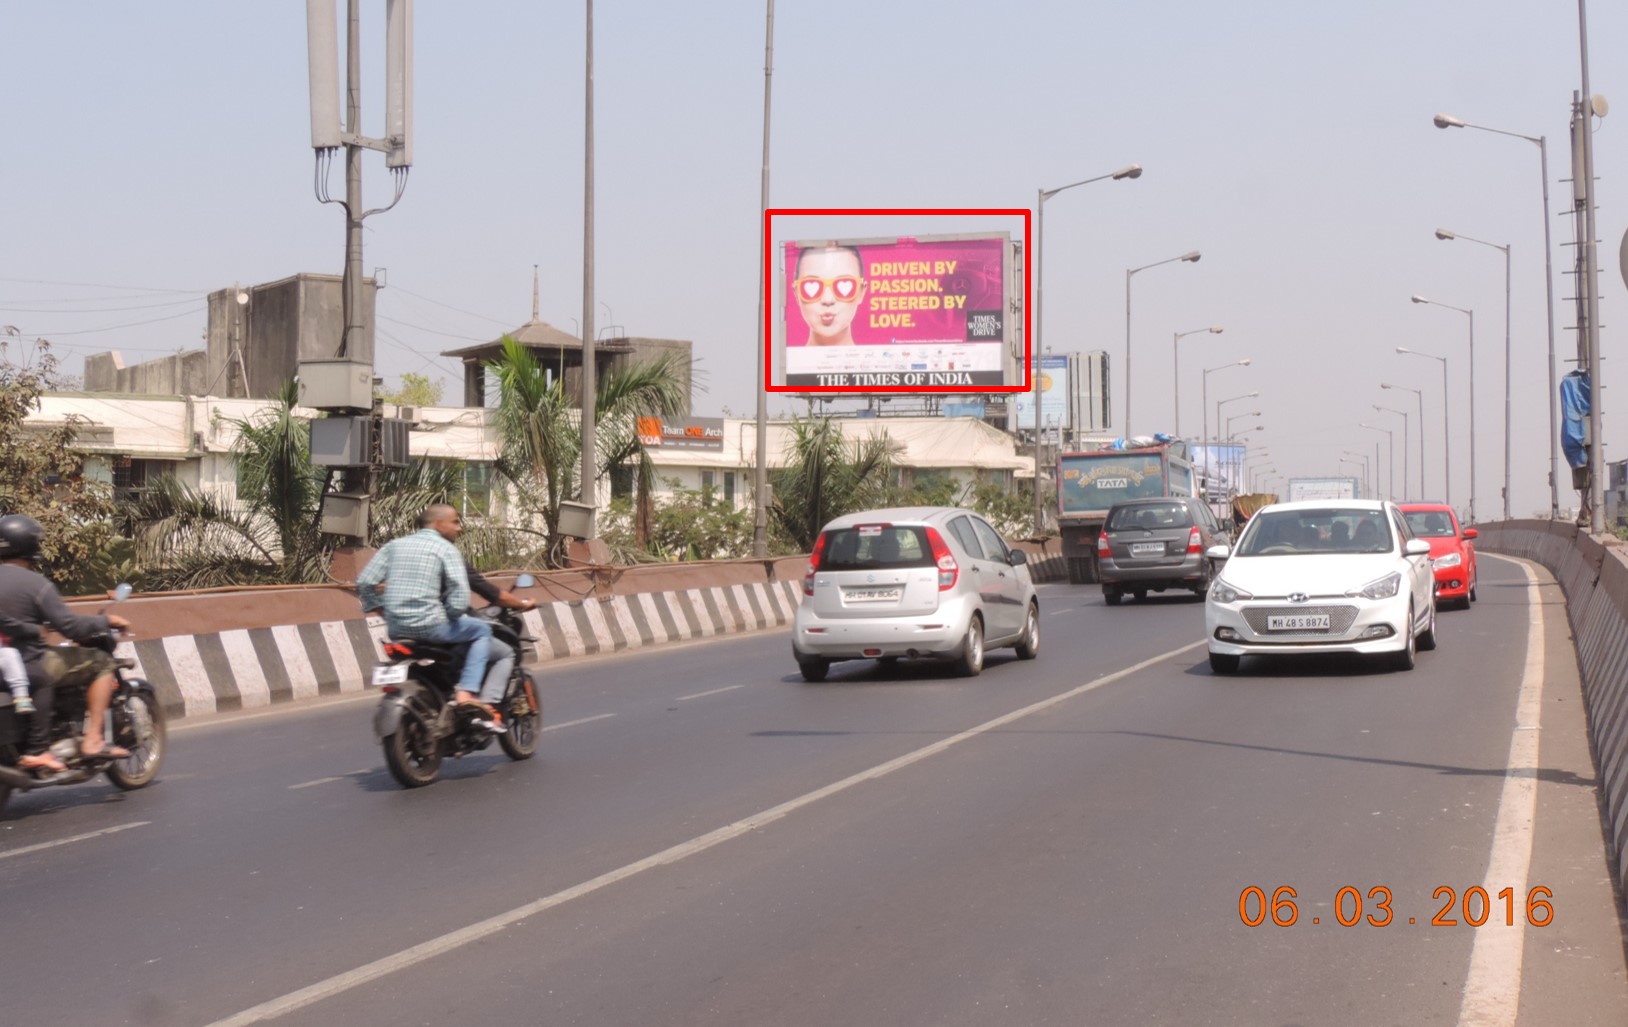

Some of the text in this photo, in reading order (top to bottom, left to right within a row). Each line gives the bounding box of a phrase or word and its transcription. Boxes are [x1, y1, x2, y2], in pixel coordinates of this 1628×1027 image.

[870, 261, 957, 276] DRIVEN BY
[870, 278, 943, 293] PASSION.
[870, 295, 966, 310] STEERED BY
[870, 313, 916, 328] LOVE.
[973, 315, 995, 323] TIMES
[967, 321, 1002, 330] WOMEN'S
[817, 372, 973, 386] THE TIMES OF INDIA
[685, 426, 703, 437] ONE
[705, 427, 722, 436] Arch
[1098, 480, 1126, 488] TATA
[1272, 618, 1328, 628] MH 48 S 8874
